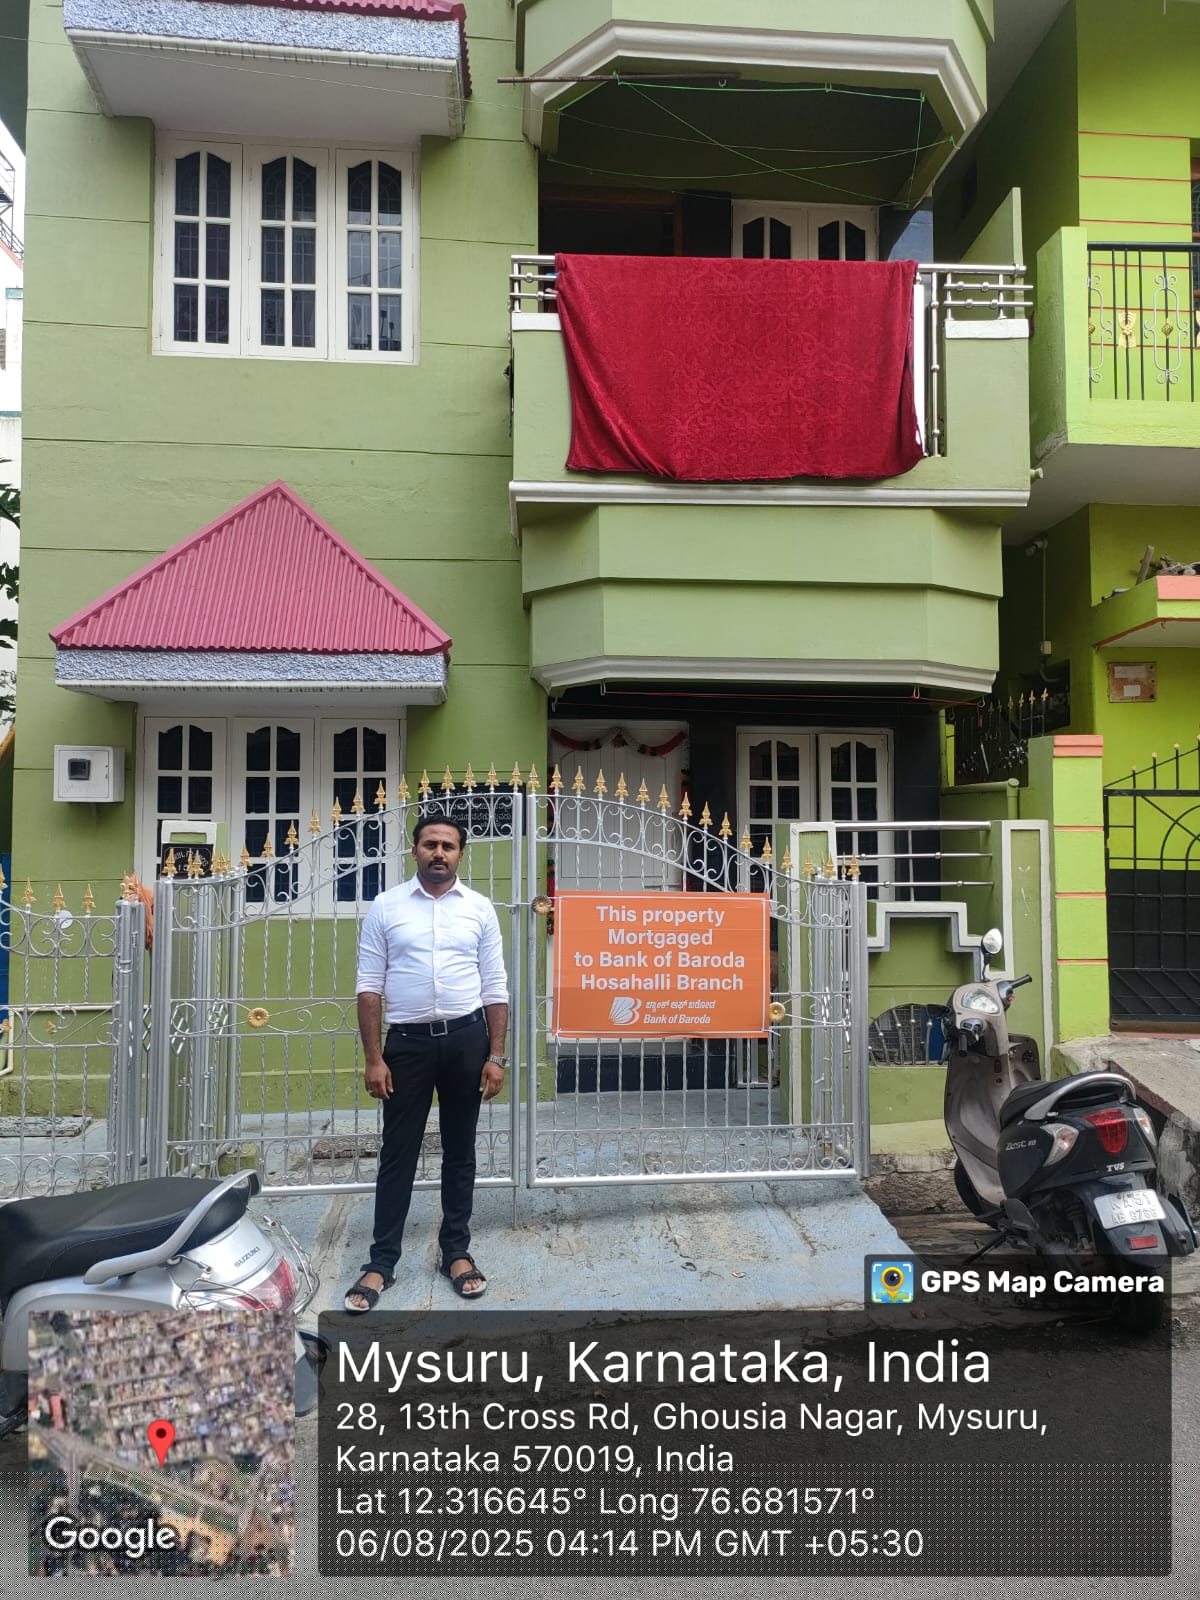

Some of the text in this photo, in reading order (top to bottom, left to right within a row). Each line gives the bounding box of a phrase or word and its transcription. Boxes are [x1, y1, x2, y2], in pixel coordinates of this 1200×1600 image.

[596, 905, 725, 927] This property
[608, 928, 713, 949] Mortgaged
[574, 951, 745, 968] to Bank of Baroda
[581, 974, 743, 991] Hosahalli Branch
[643, 1013, 711, 1024] Bank of Baroda
[1106, 1162, 1125, 1173] TVS
[233, 1246, 261, 1268] SUZUKI
